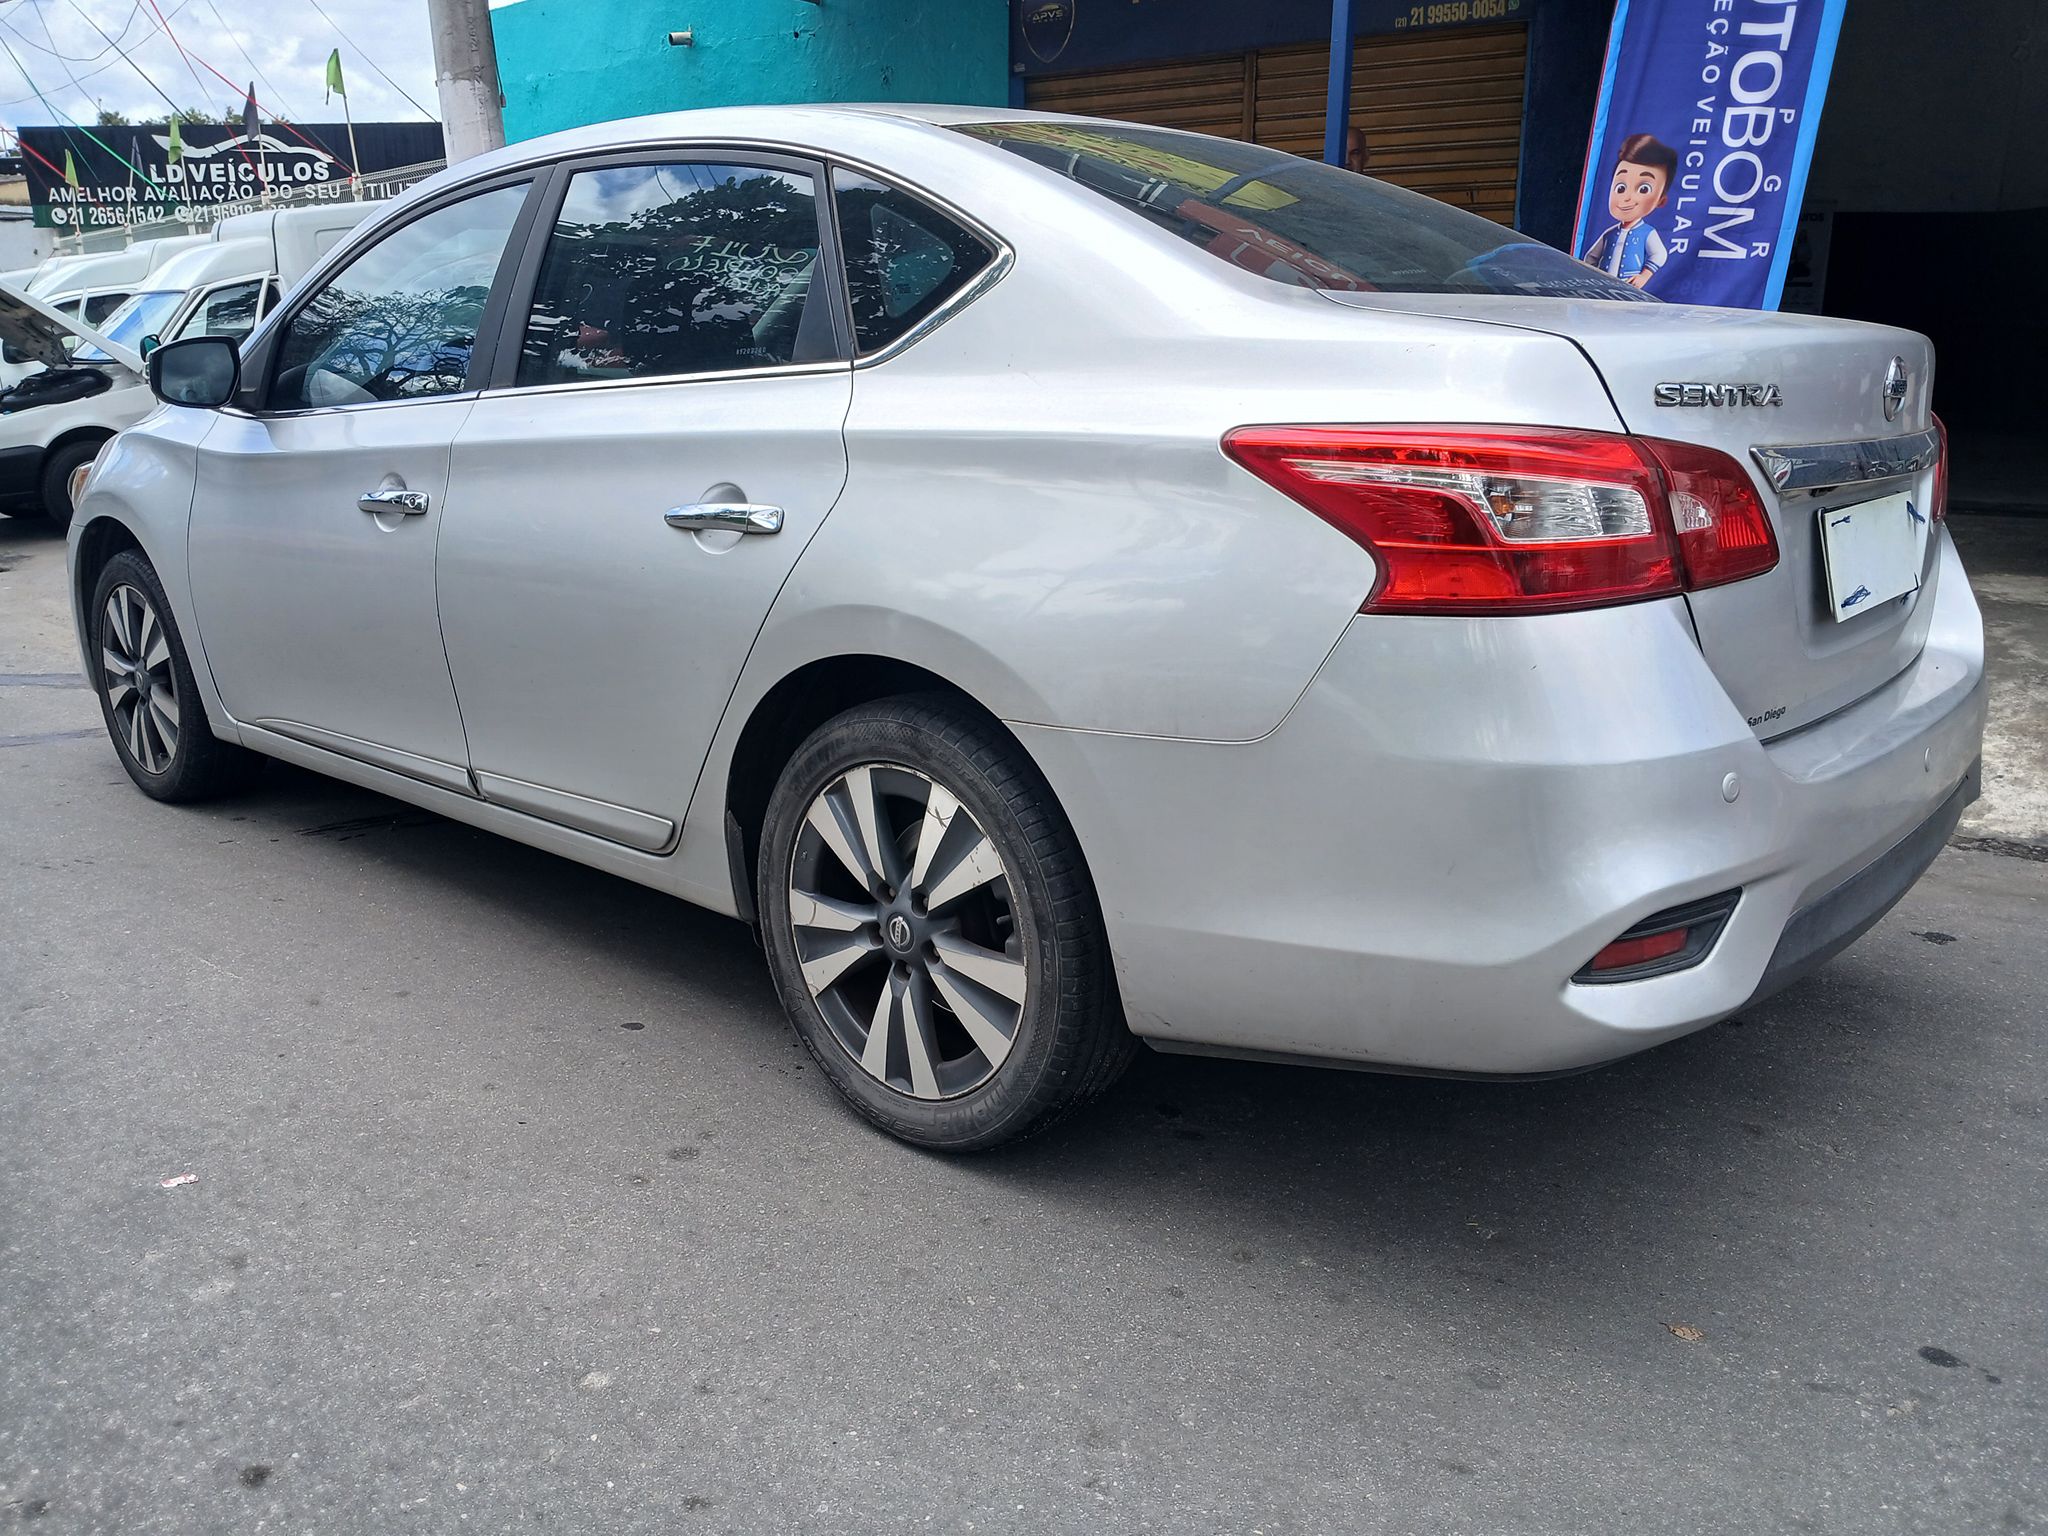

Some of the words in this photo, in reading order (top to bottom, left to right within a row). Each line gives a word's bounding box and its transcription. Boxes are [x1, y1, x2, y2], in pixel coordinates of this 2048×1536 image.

[1032, 9, 1064, 21] APVS
[1410, 6, 1425, 26] 21
[1427, 0, 1506, 25] 99550-0054
[151, 163, 185, 183] LD
[187, 158, 330, 184] VEÍCULOS
[1669, 95, 1717, 255] VEICULAR
[144, 182, 254, 203] AVALIAÇÃO
[266, 185, 294, 200] DO
[305, 183, 341, 199] SEU
[67, 206, 85, 225] 21
[193, 205, 209, 223] 21
[1655, 382, 1784, 408] SENTRA
[1764, 706, 1786, 722] Diego
